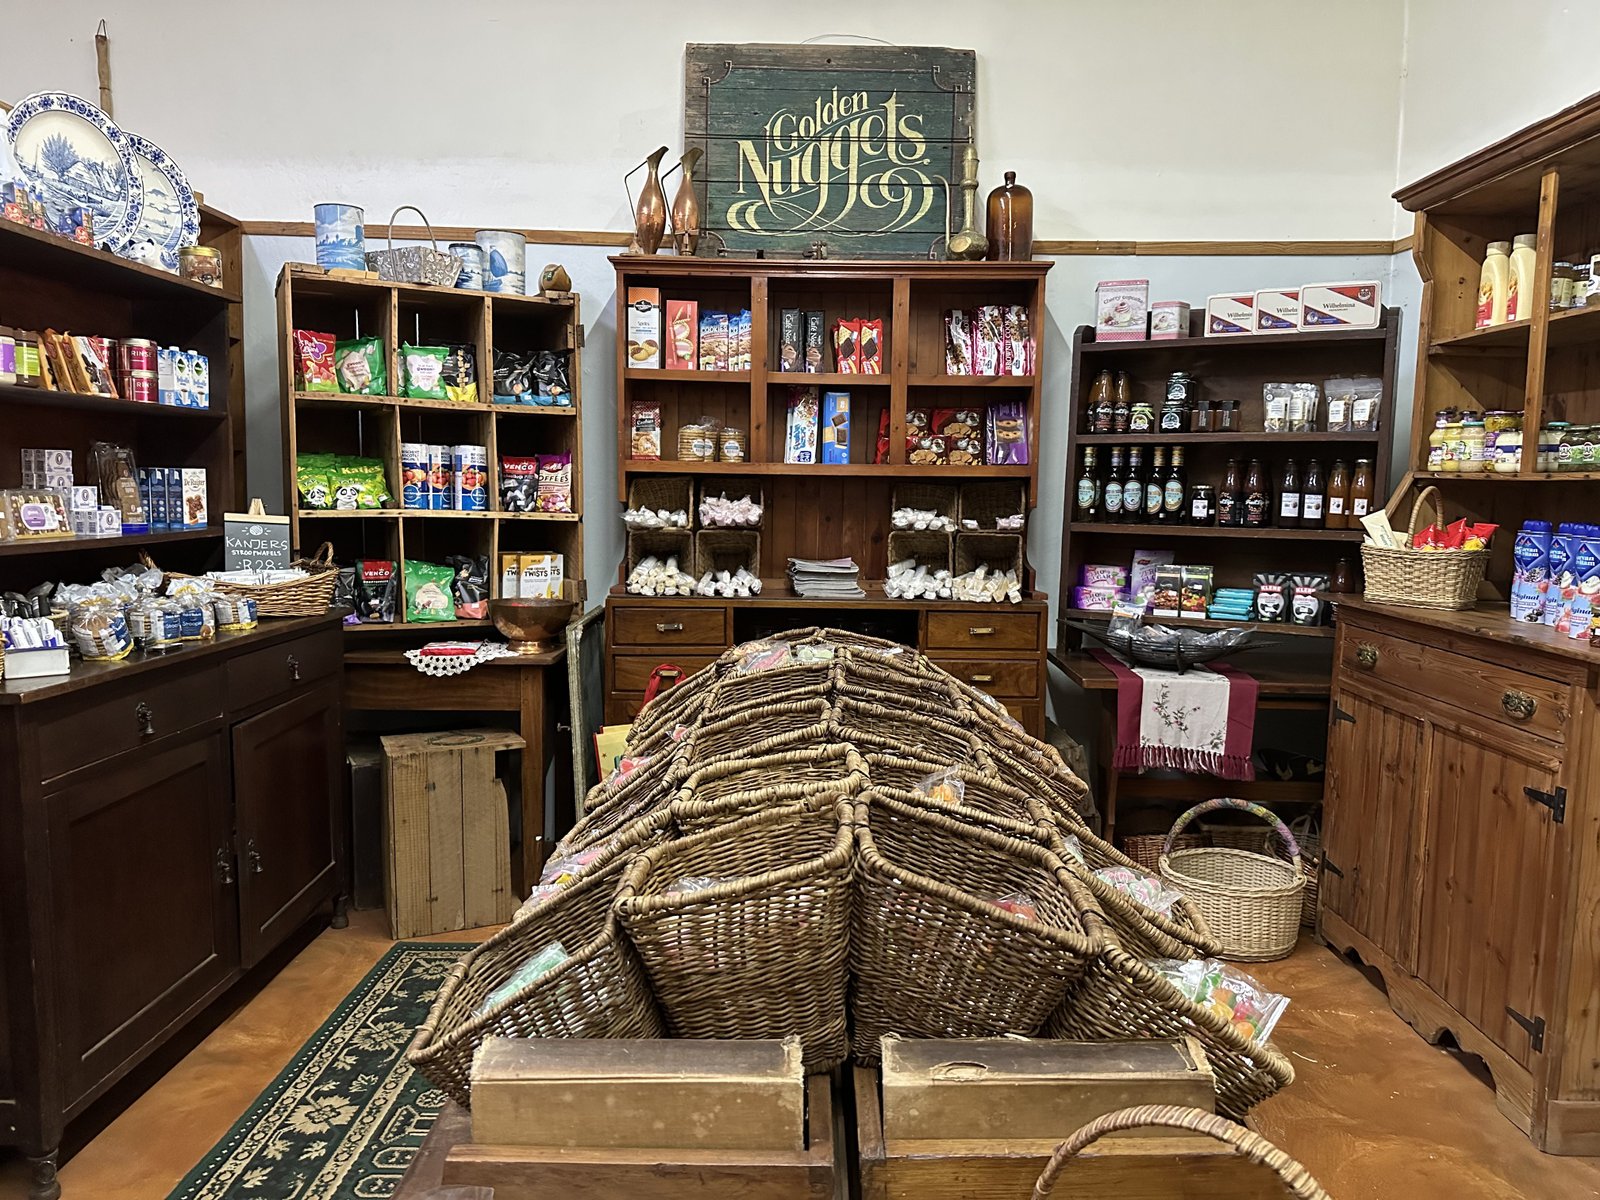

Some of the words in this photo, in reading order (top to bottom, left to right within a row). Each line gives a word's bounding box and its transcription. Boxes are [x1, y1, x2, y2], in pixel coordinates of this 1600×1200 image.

[772, 86, 870, 153] Golden
[733, 90, 932, 220] Nuggets
[342, 465, 382, 475] Katjes
[504, 463, 534, 471] VENCO
[226, 536, 288, 551] KANJERS
[231, 549, 282, 557] STROOPWAFELS
